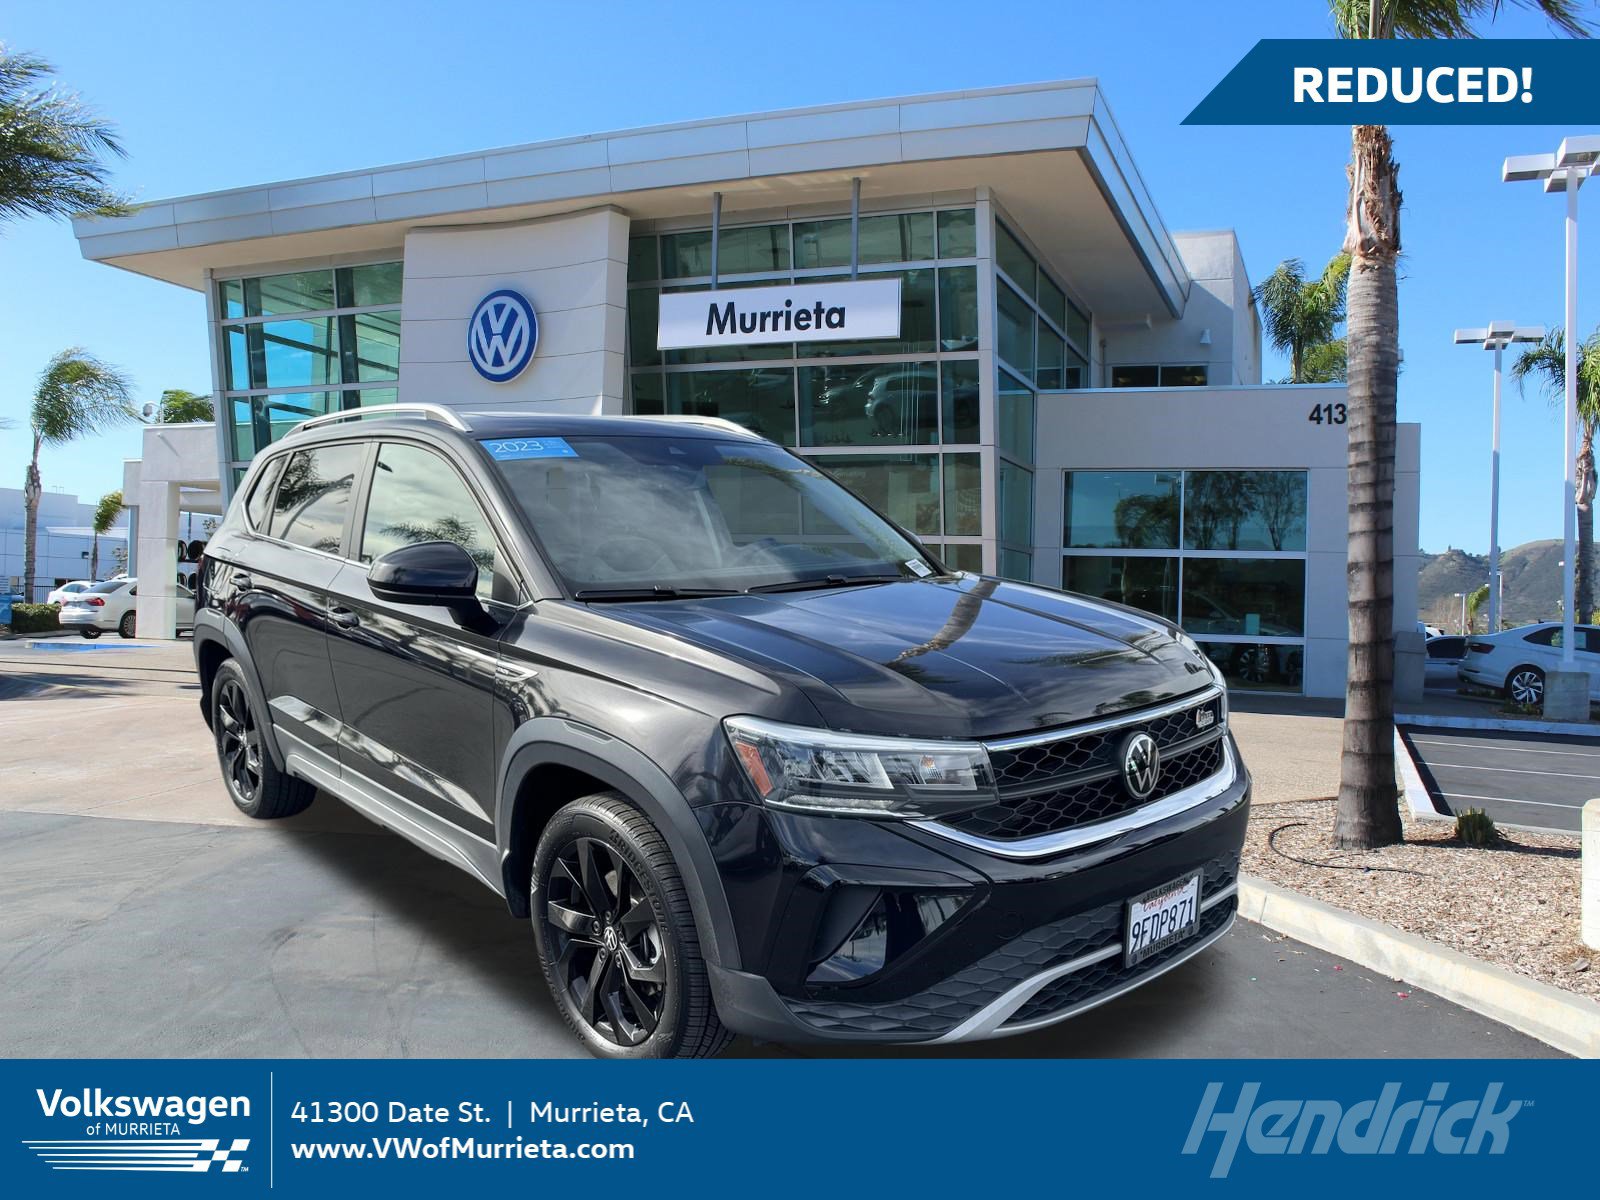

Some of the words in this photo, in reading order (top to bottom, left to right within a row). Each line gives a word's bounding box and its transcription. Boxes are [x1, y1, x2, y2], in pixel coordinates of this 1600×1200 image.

[706, 299, 847, 336] Murrieta
[489, 440, 544, 453] 2023
[1130, 896, 1194, 954] 9FDP871
